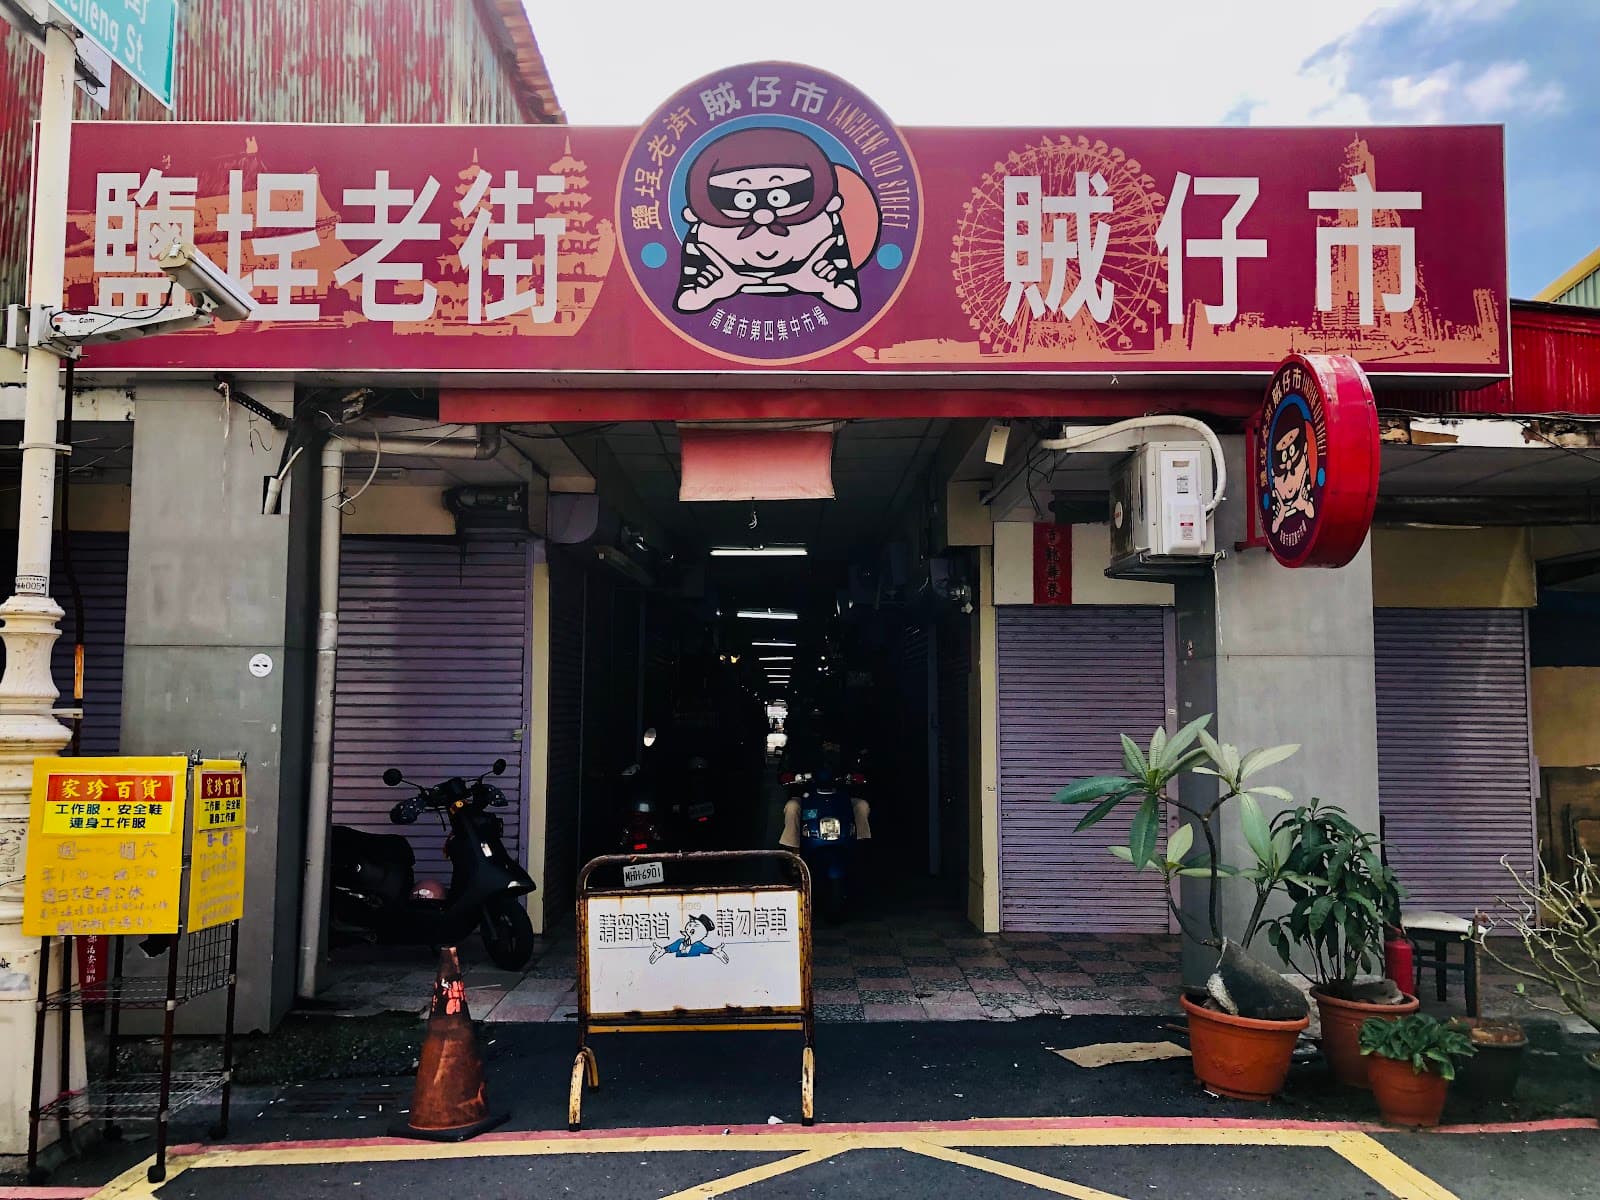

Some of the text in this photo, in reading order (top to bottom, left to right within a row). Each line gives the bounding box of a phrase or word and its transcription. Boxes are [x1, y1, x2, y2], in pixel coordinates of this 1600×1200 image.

[700, 75, 828, 121] 賊仔市
[827, 96, 910, 230] YANCHENG OLD STREET
[1000, 170, 1423, 325] 賊仔市
[709, 305, 829, 342] 高雄市第四集中市場
[61, 778, 162, 800] 家珍百貨
[206, 777, 240, 797] 家珍百貨
[70, 817, 146, 829] 連身工作服
[599, 906, 788, 943] 請留通道 請勿停車
